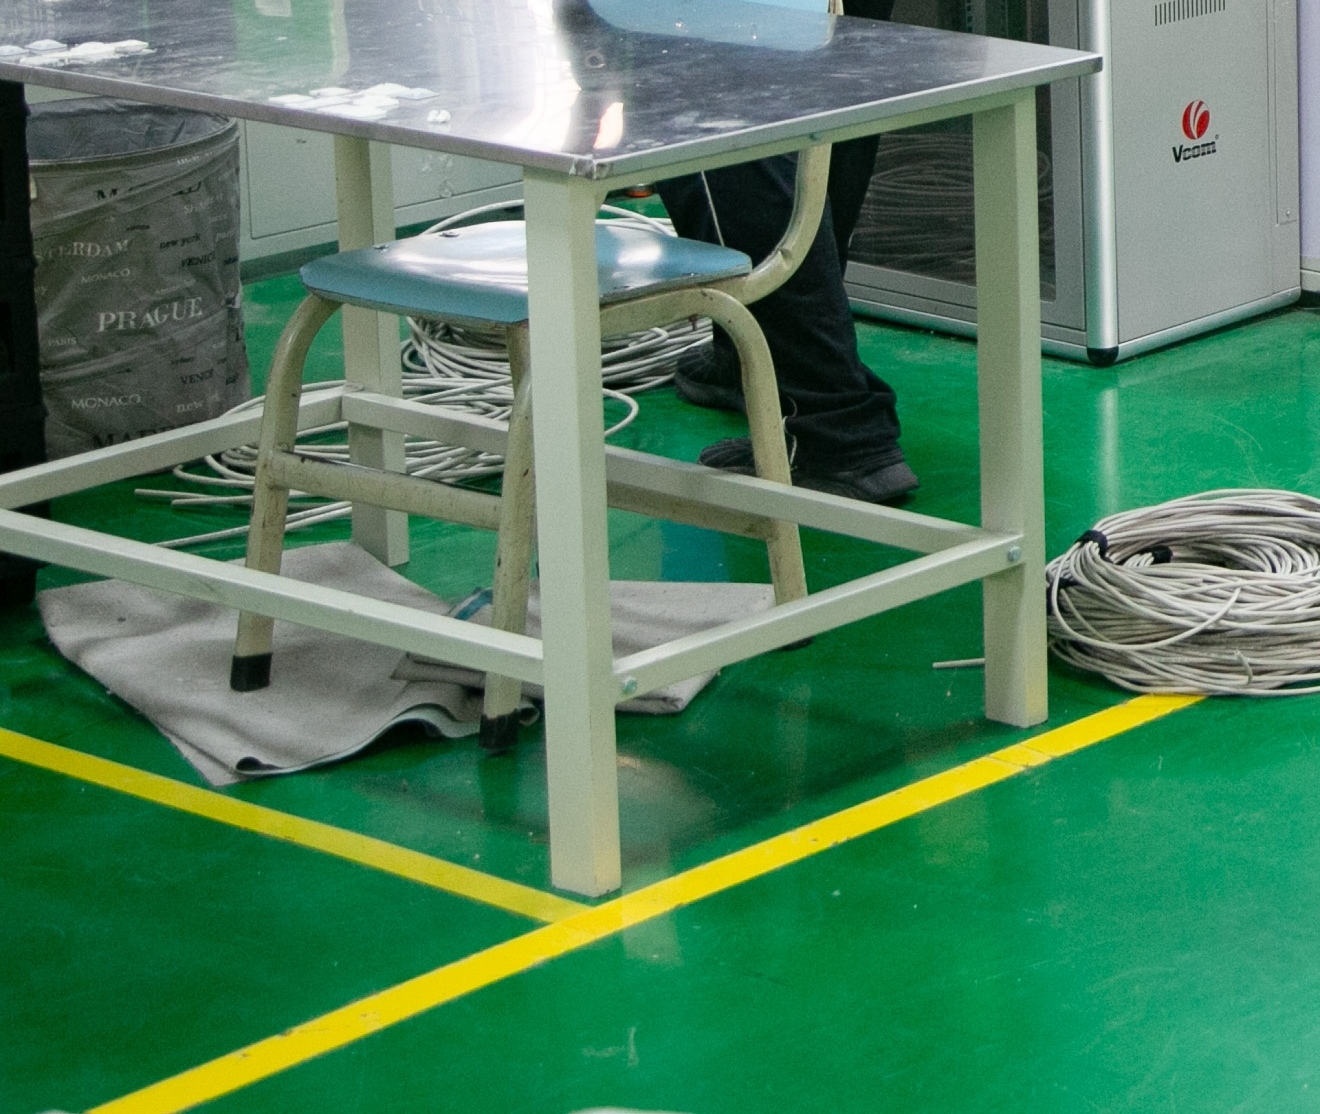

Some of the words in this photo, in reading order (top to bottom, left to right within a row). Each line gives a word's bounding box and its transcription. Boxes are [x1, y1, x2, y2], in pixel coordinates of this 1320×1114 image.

[1172, 141, 1217, 163] Vcom
[97, 296, 204, 333] PRAGUE
[71, 393, 142, 410] MONACO
